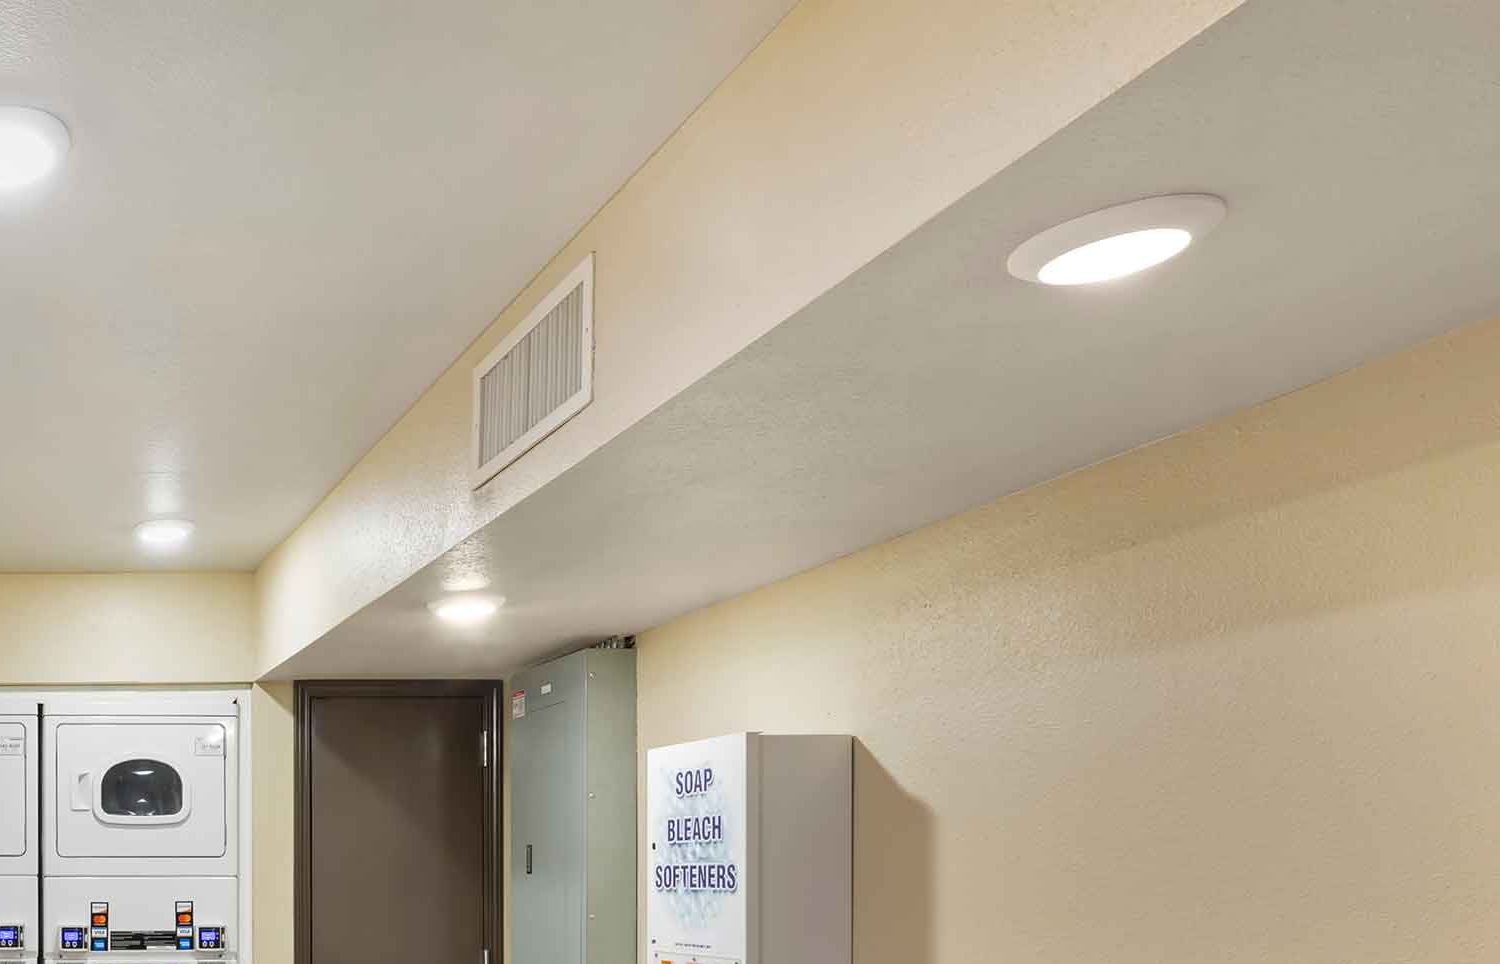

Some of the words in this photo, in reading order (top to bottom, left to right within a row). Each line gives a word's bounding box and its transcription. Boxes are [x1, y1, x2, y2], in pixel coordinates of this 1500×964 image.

[675, 768, 713, 795] SOAP
[667, 815, 722, 842] BLEACH
[655, 863, 737, 889] SOFTENERS
